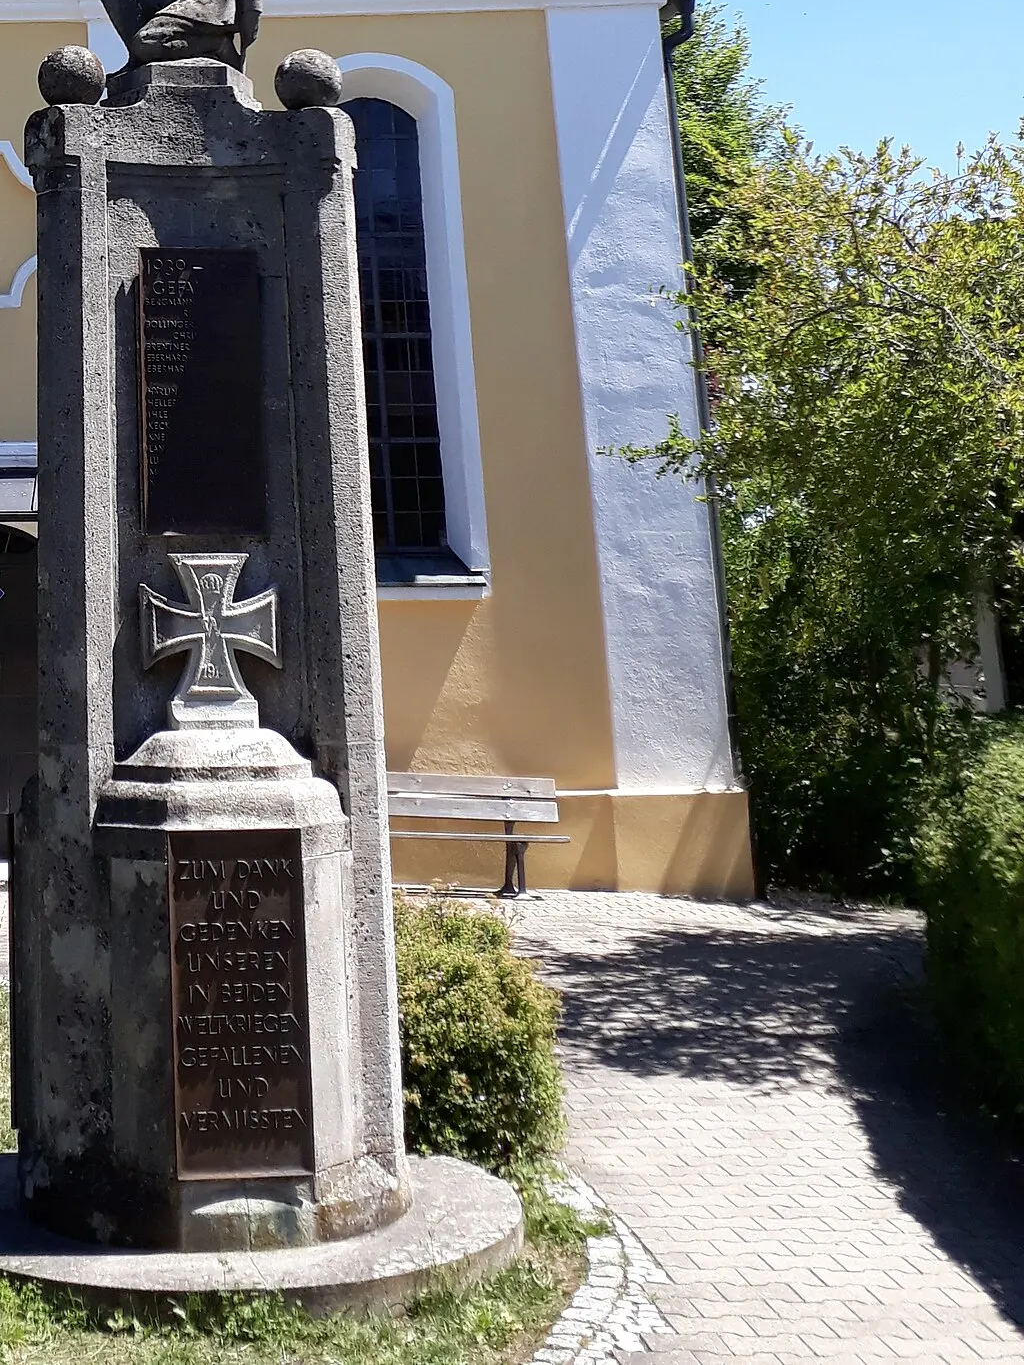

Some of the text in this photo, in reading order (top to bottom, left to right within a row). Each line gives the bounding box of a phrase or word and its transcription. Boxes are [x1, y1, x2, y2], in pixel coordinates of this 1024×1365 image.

[146, 258, 186, 276] 1939
[178, 859, 294, 880] ZUM DANK
[211, 890, 261, 909] UND
[180, 920, 296, 942] GEDENKEN
[187, 951, 291, 972] UNSEREN
[188, 982, 292, 1004] IN BEIDEN
[178, 1013, 305, 1035] WELTKRIEGEN
[181, 1044, 305, 1067] GEFALLENEN
[218, 1077, 269, 1098] UND
[181, 1108, 308, 1132] VERMISSTEN
